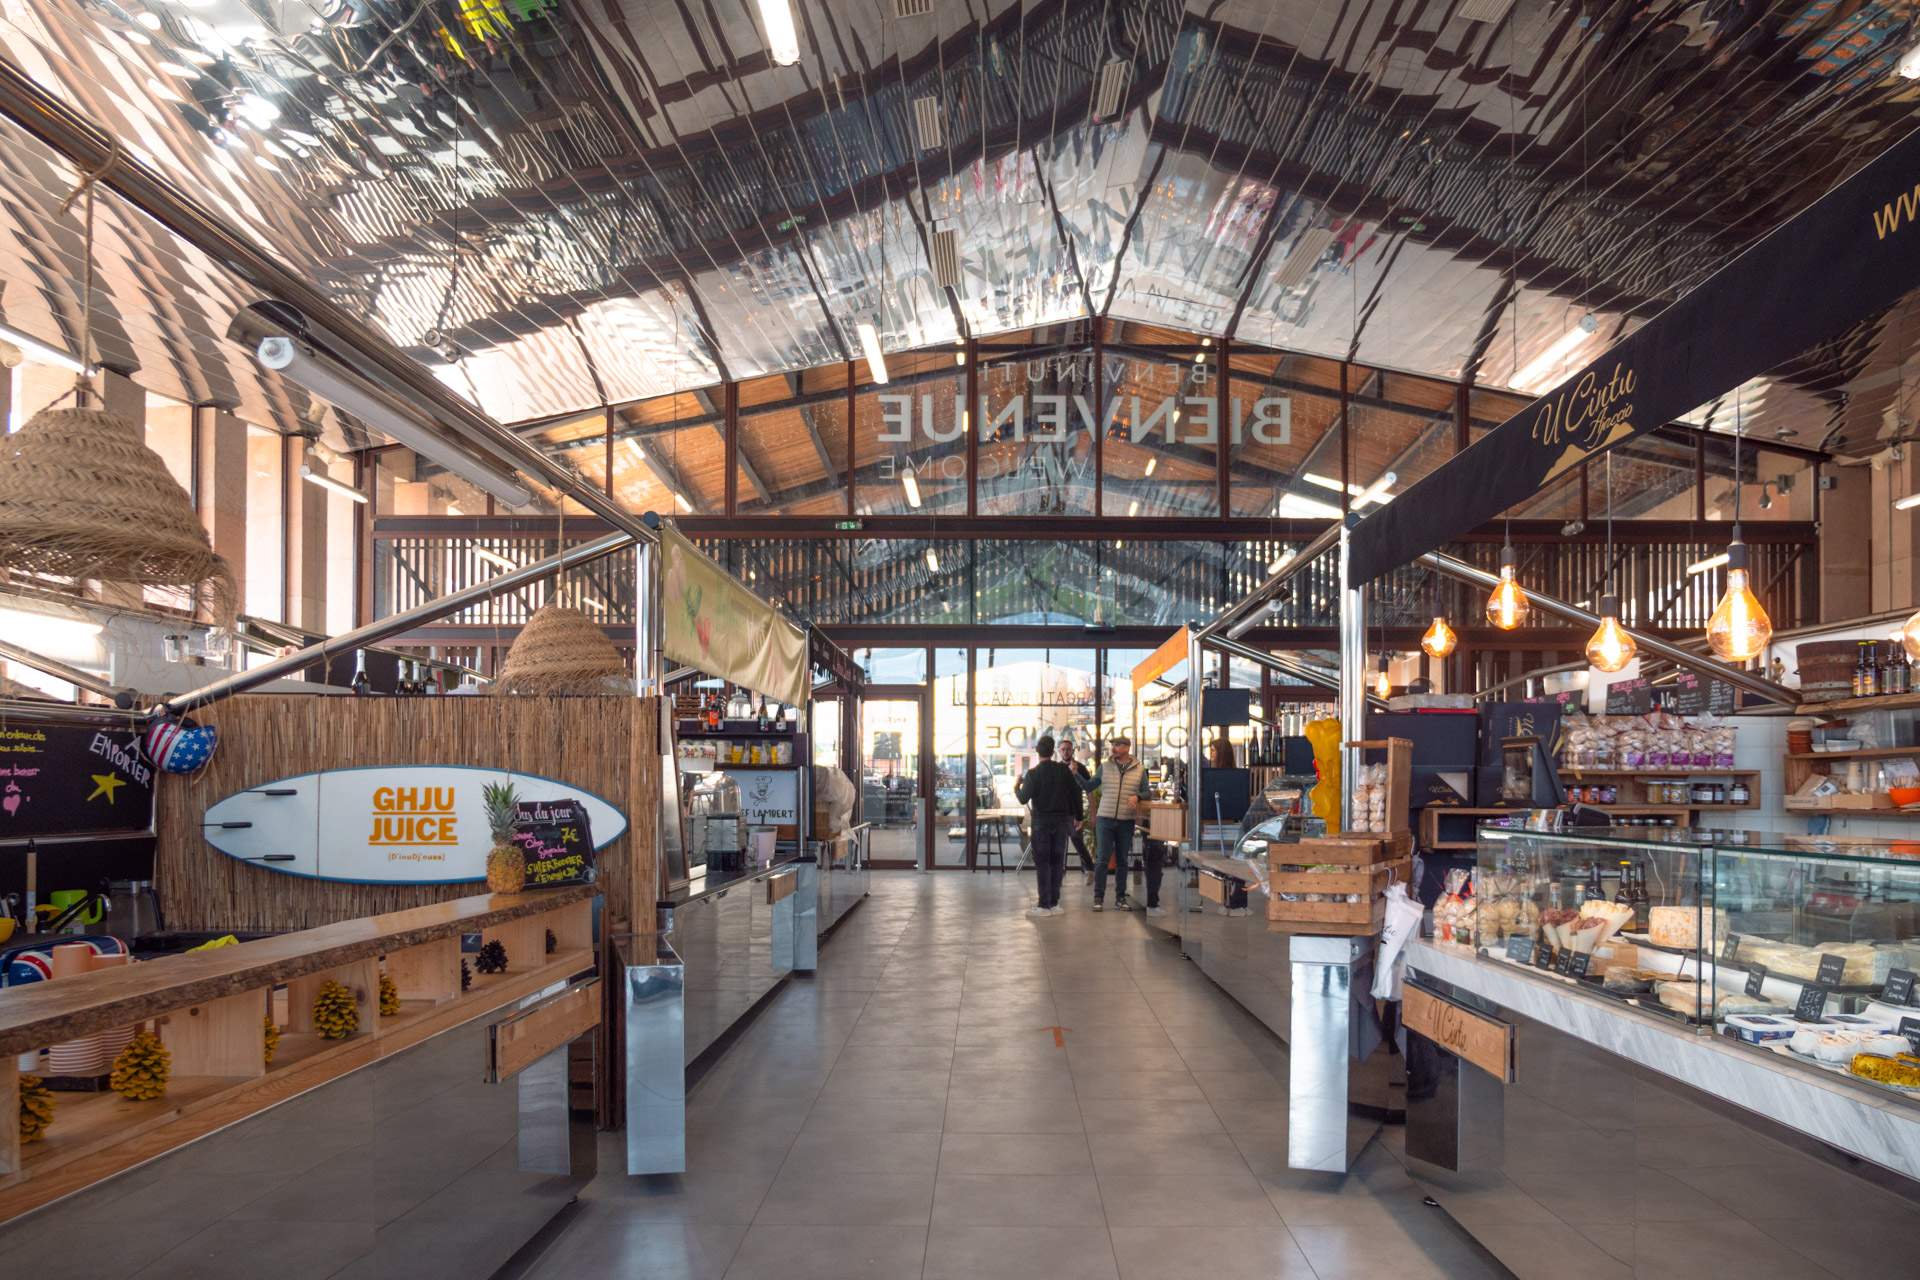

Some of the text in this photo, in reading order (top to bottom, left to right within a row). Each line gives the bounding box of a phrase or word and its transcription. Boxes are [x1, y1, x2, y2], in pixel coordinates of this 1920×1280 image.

[1532, 362, 1637, 446] U Cintu
[89, 732, 151, 789] EMPORTER
[373, 786, 455, 811] GHJU
[534, 803, 549, 819] du
[550, 806, 573, 825] jour
[753, 808, 795, 818] LAMBERT
[368, 817, 458, 842] JUICE
